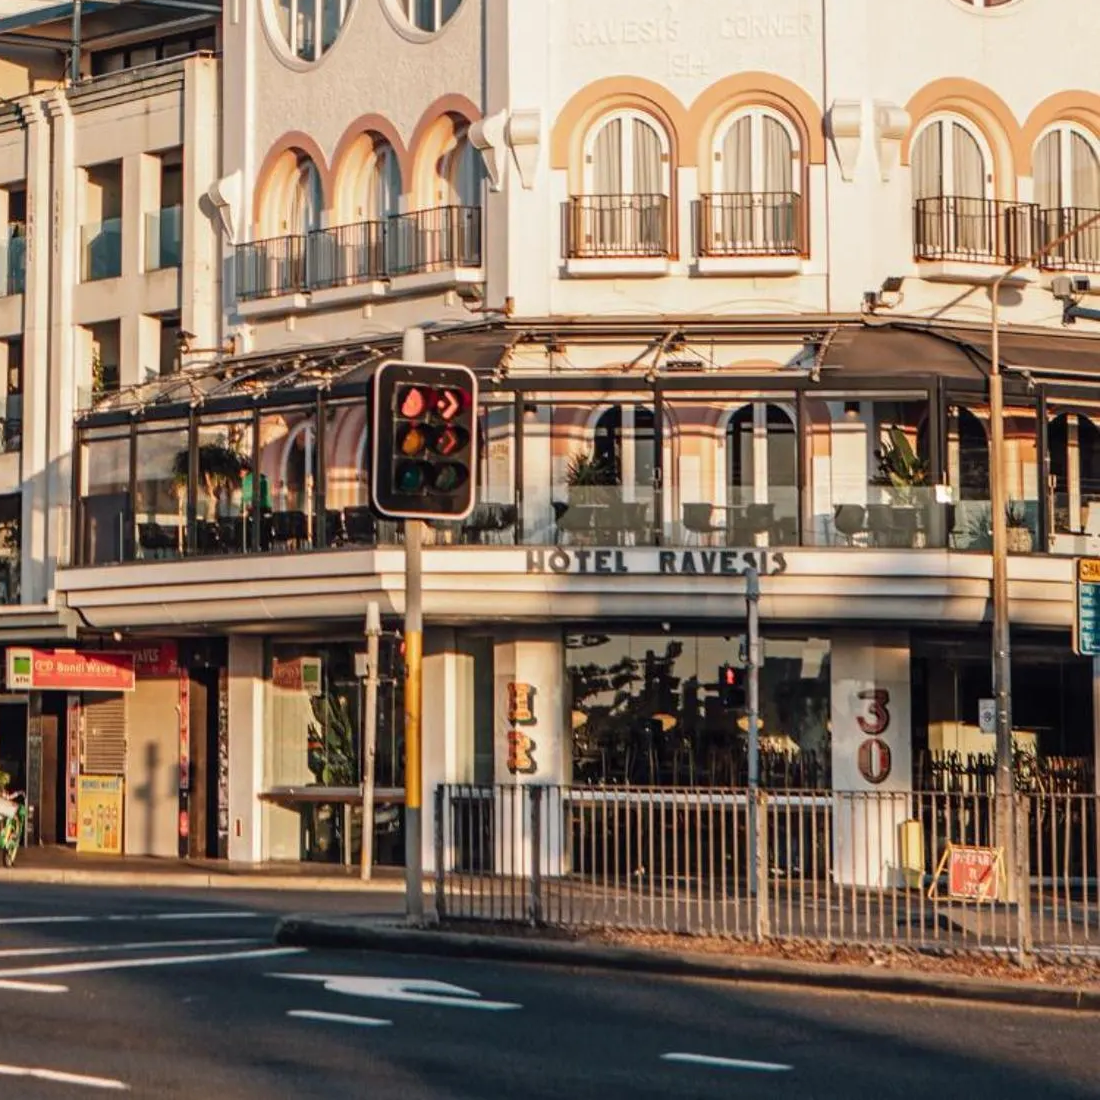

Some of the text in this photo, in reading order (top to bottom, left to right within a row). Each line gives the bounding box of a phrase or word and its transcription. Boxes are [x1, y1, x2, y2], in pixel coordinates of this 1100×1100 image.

[719, 14, 813, 40] CORNER
[526, 551, 787, 576] HOTEL RAVESIS
[57, 661, 116, 675] Bondi Waves
